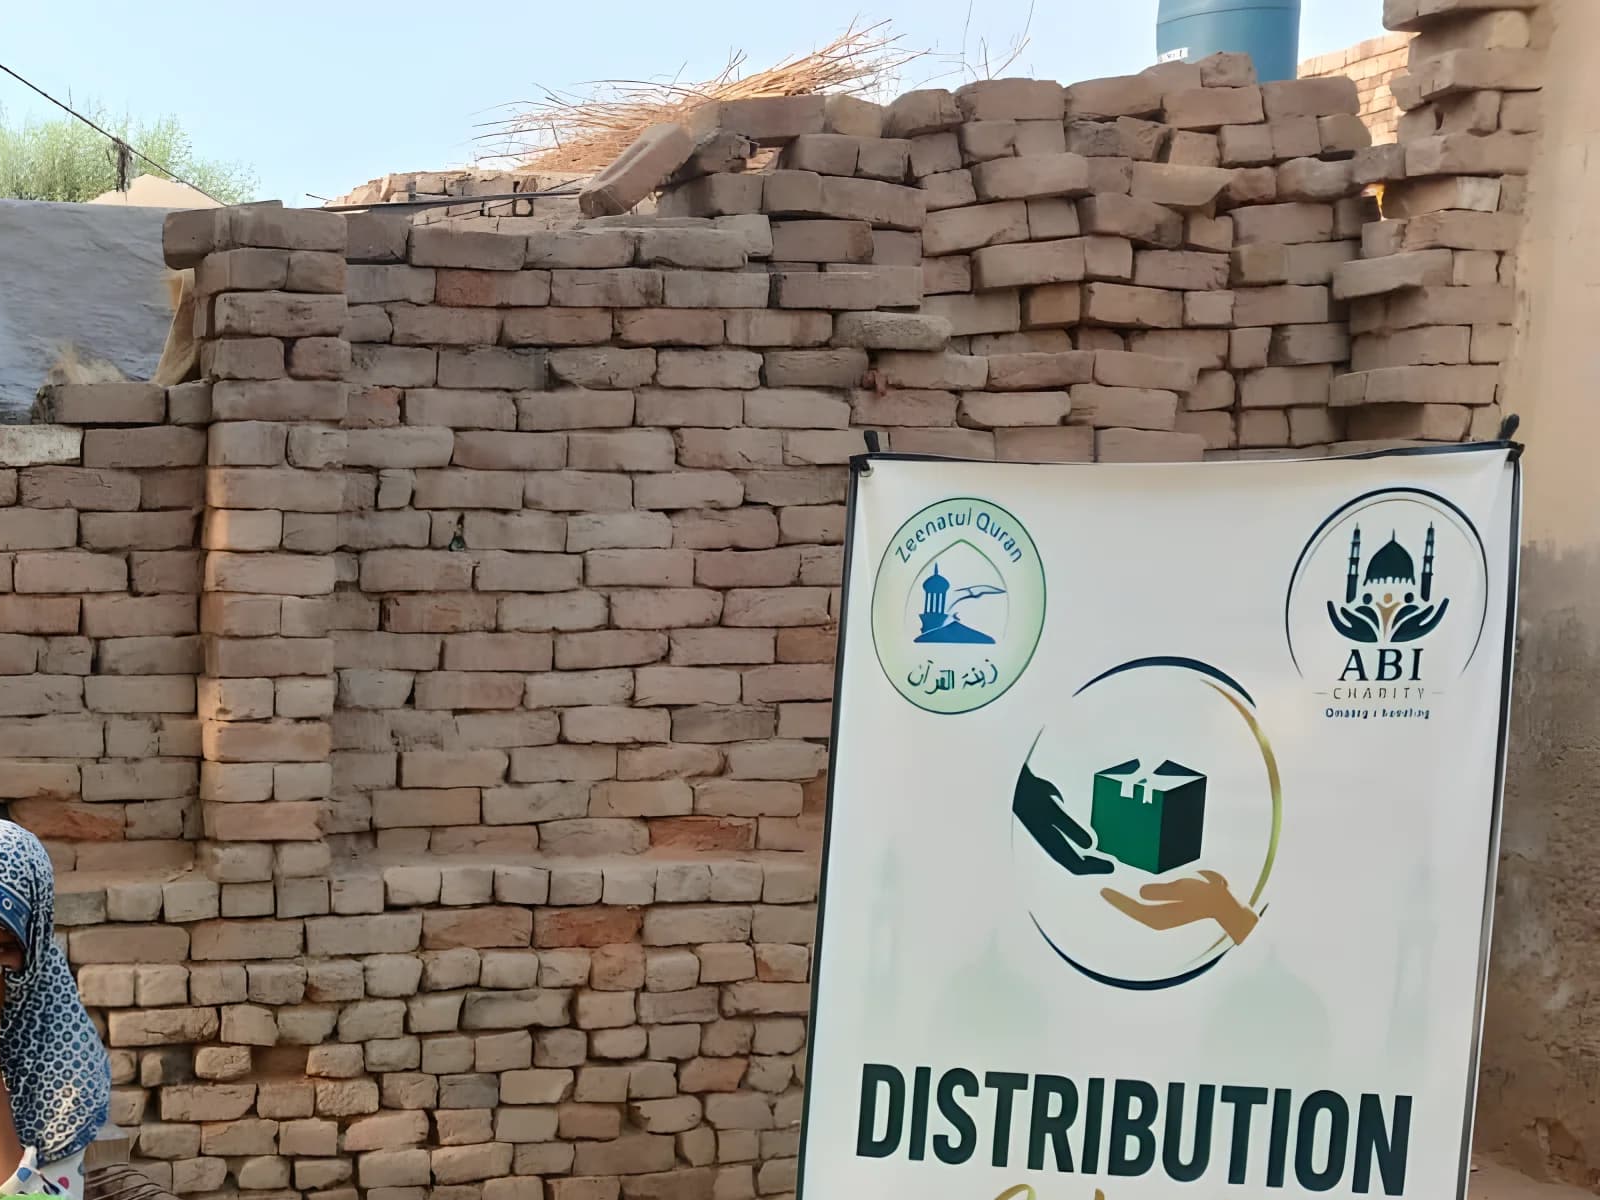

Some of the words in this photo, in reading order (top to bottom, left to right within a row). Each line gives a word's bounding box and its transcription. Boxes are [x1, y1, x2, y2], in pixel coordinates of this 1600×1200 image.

[895, 507, 972, 563] Zeenatul
[976, 512, 1023, 563] Quran
[1337, 648, 1424, 681] ABI
[855, 1063, 1413, 1197] DISTRIBUTION
